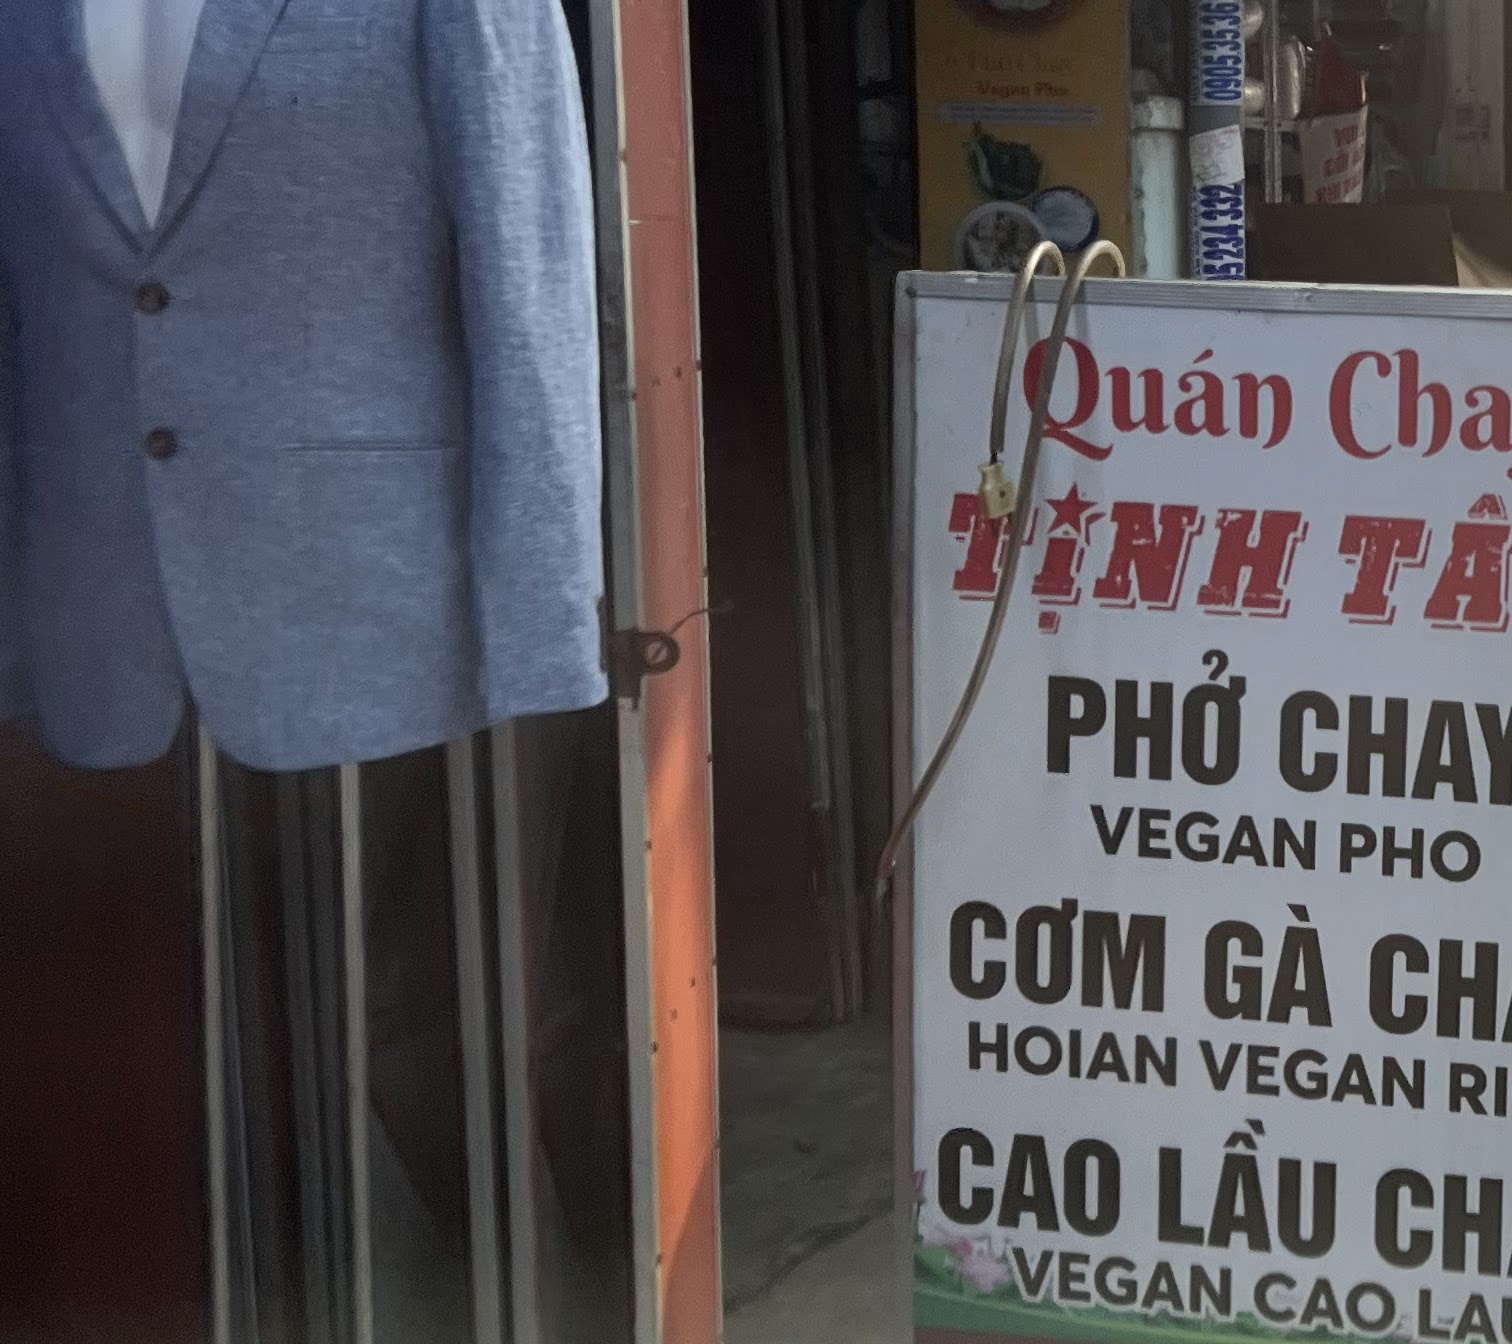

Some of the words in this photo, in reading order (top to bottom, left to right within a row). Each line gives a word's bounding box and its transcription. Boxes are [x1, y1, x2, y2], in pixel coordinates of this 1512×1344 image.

[1022, 336, 1293, 461] Quán
[947, 482, 1311, 636] TỊNH
[1045, 649, 1246, 786] PHỞ
[1090, 804, 1318, 873] VEGAN
[1338, 823, 1482, 883] PHO
[948, 896, 1168, 1015] CƠM
[1203, 903, 1334, 1029] GÀ
[967, 1021, 1179, 1088] HOIAN
[1198, 1042, 1426, 1111] VEGAN
[935, 1126, 1123, 1238] CAO
[1157, 1117, 1338, 1261] LẦU
[1010, 1247, 1234, 1319] VEGAN
[1252, 1270, 1396, 1335] CAO
